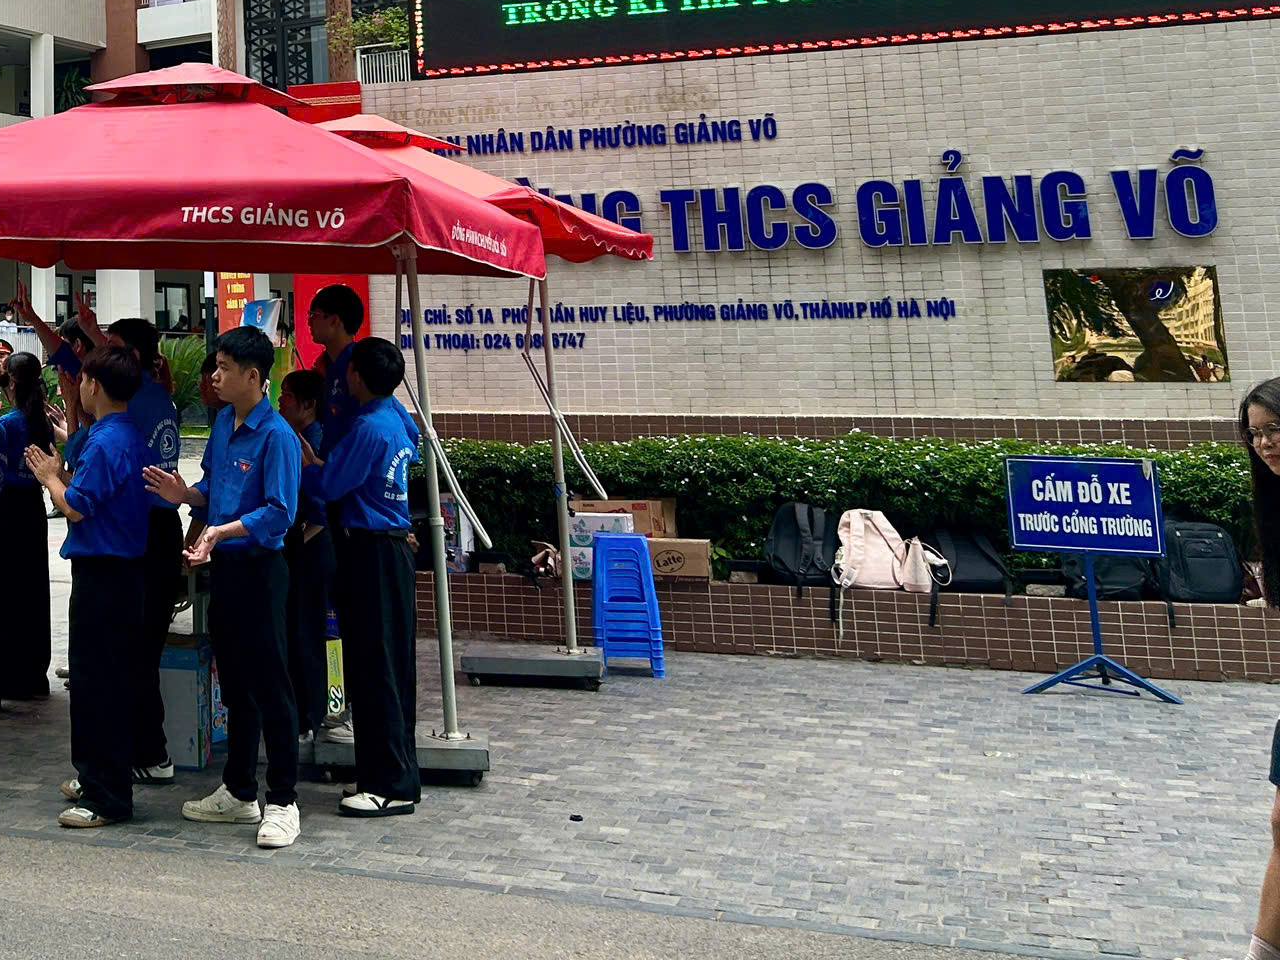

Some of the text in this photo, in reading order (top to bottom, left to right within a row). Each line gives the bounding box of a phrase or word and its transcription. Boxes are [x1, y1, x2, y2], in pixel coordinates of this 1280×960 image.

[426, 112, 778, 158] AN NHÂN DÂN PHƯỜNG GIẢNG VÕ
[660, 182, 839, 253] THCS
[856, 149, 1093, 249] GIẢNG
[1109, 147, 1220, 240] VÕ
[180, 202, 345, 230] THCS GIẢNG VÕ
[424, 303, 452, 325] CHỈ:
[455, 303, 474, 325] SỐ
[477, 308, 494, 324] 1A
[579, 306, 607, 323] HUY
[613, 302, 650, 325] LIỆU,
[654, 301, 716, 322] PHƯỜNG
[720, 298, 769, 321] GIẢNG
[773, 299, 799, 321] VÕ,
[897, 298, 921, 319] HÀ
[927, 297, 956, 321] NỘI
[400, 334, 430, 349] ĐIN
[435, 334, 480, 353] THOẠI:
[483, 333, 511, 349] 024
[1031, 472, 1132, 505] CẤM ĐỖ XE
[1018, 509, 1153, 538] TRƯỚC CỔNG TRƯỜNG
[655, 553, 683, 568] Latte
